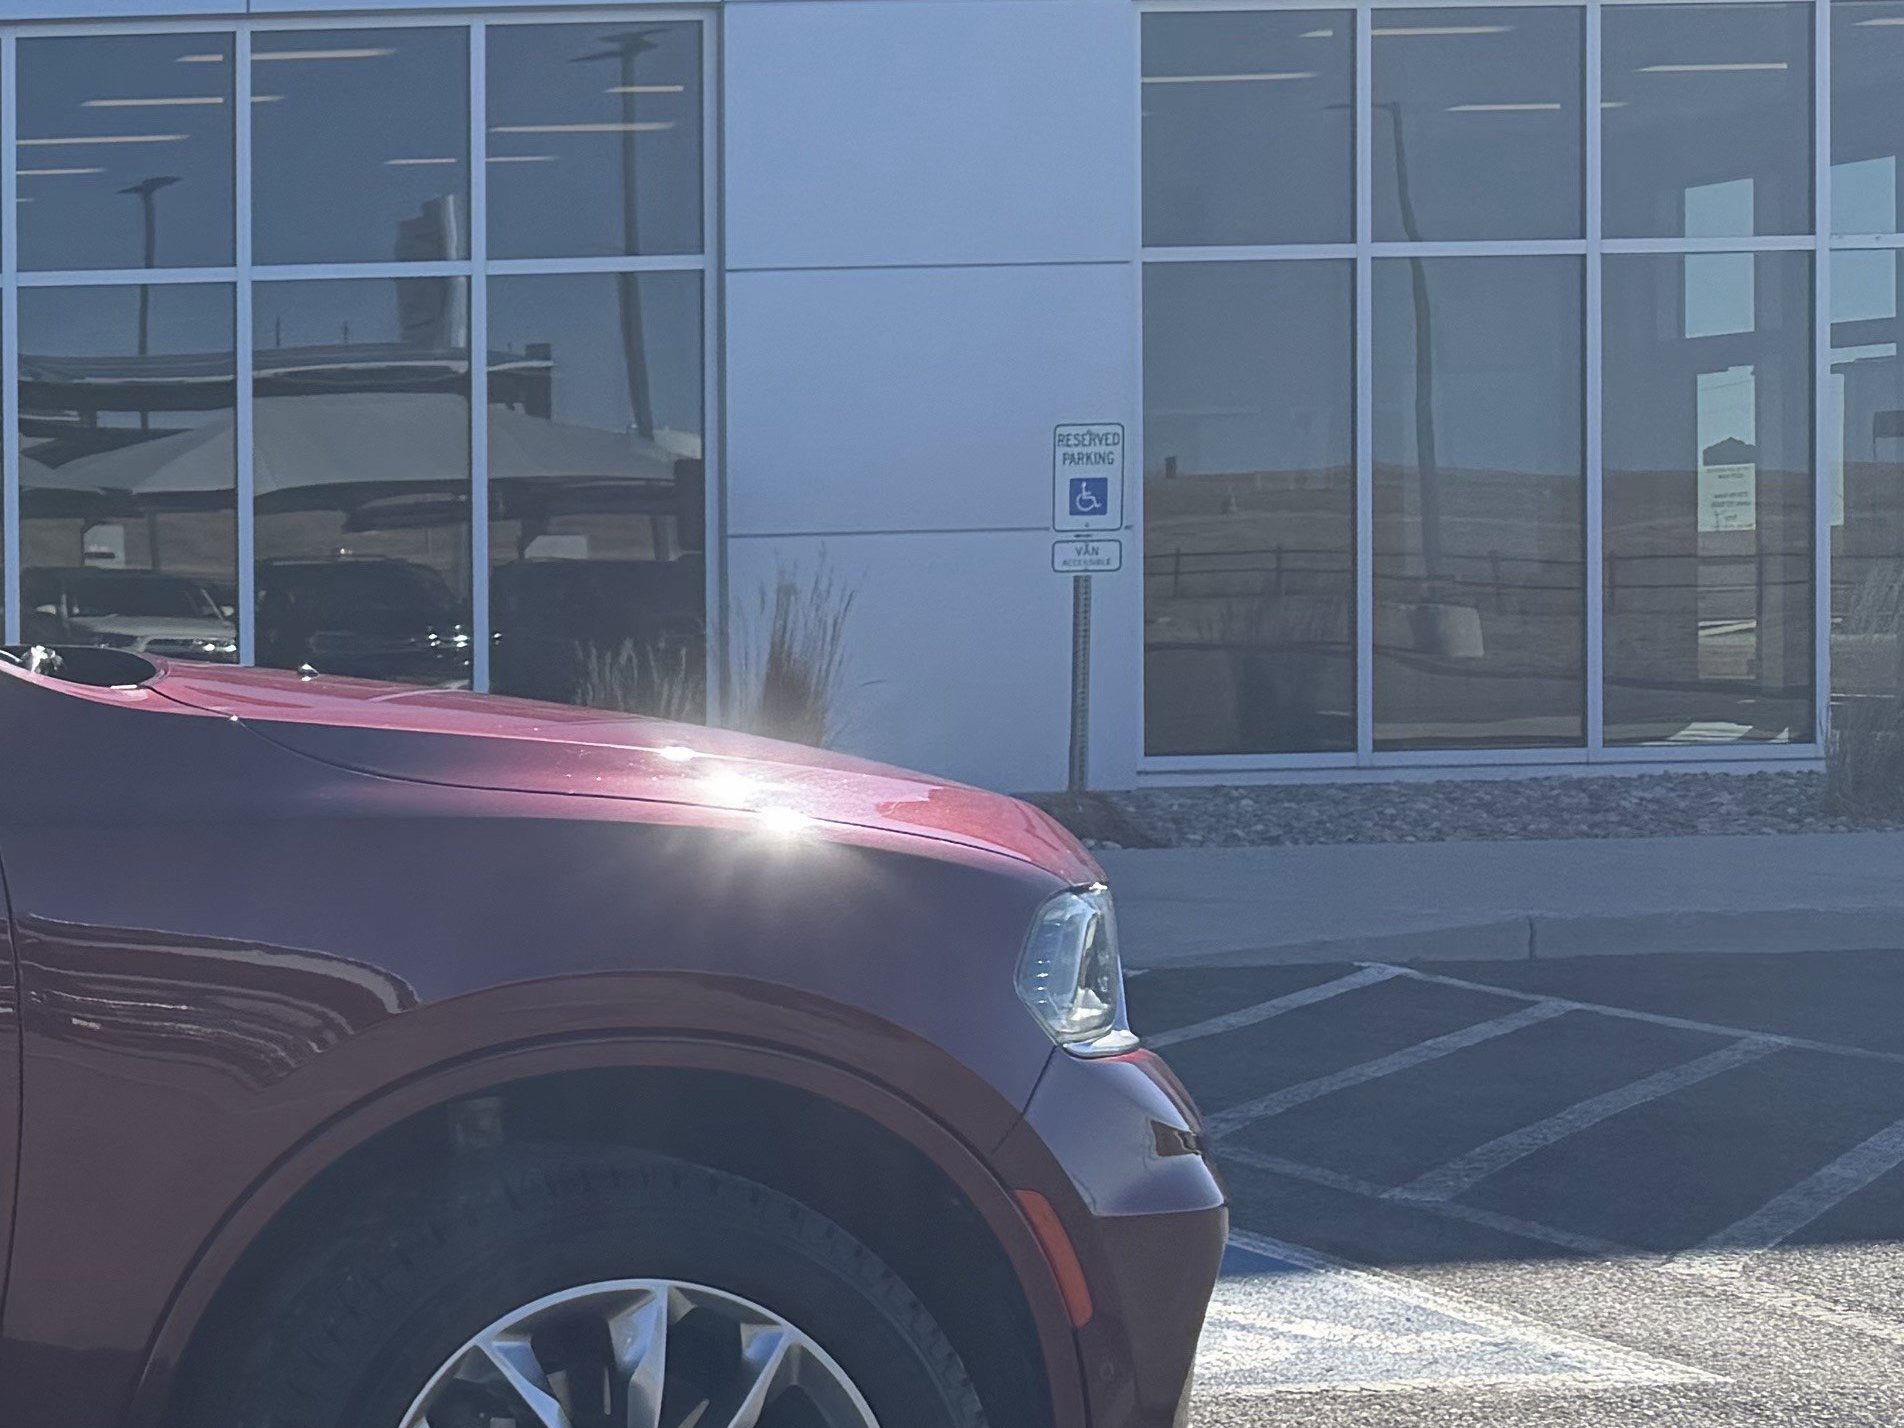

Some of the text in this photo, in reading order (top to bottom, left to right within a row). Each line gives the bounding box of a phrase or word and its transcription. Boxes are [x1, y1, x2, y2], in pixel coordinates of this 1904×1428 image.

[1057, 432, 1120, 447] RESERVED
[1062, 451, 1114, 466] PARKING
[1074, 545, 1099, 556] VAN
